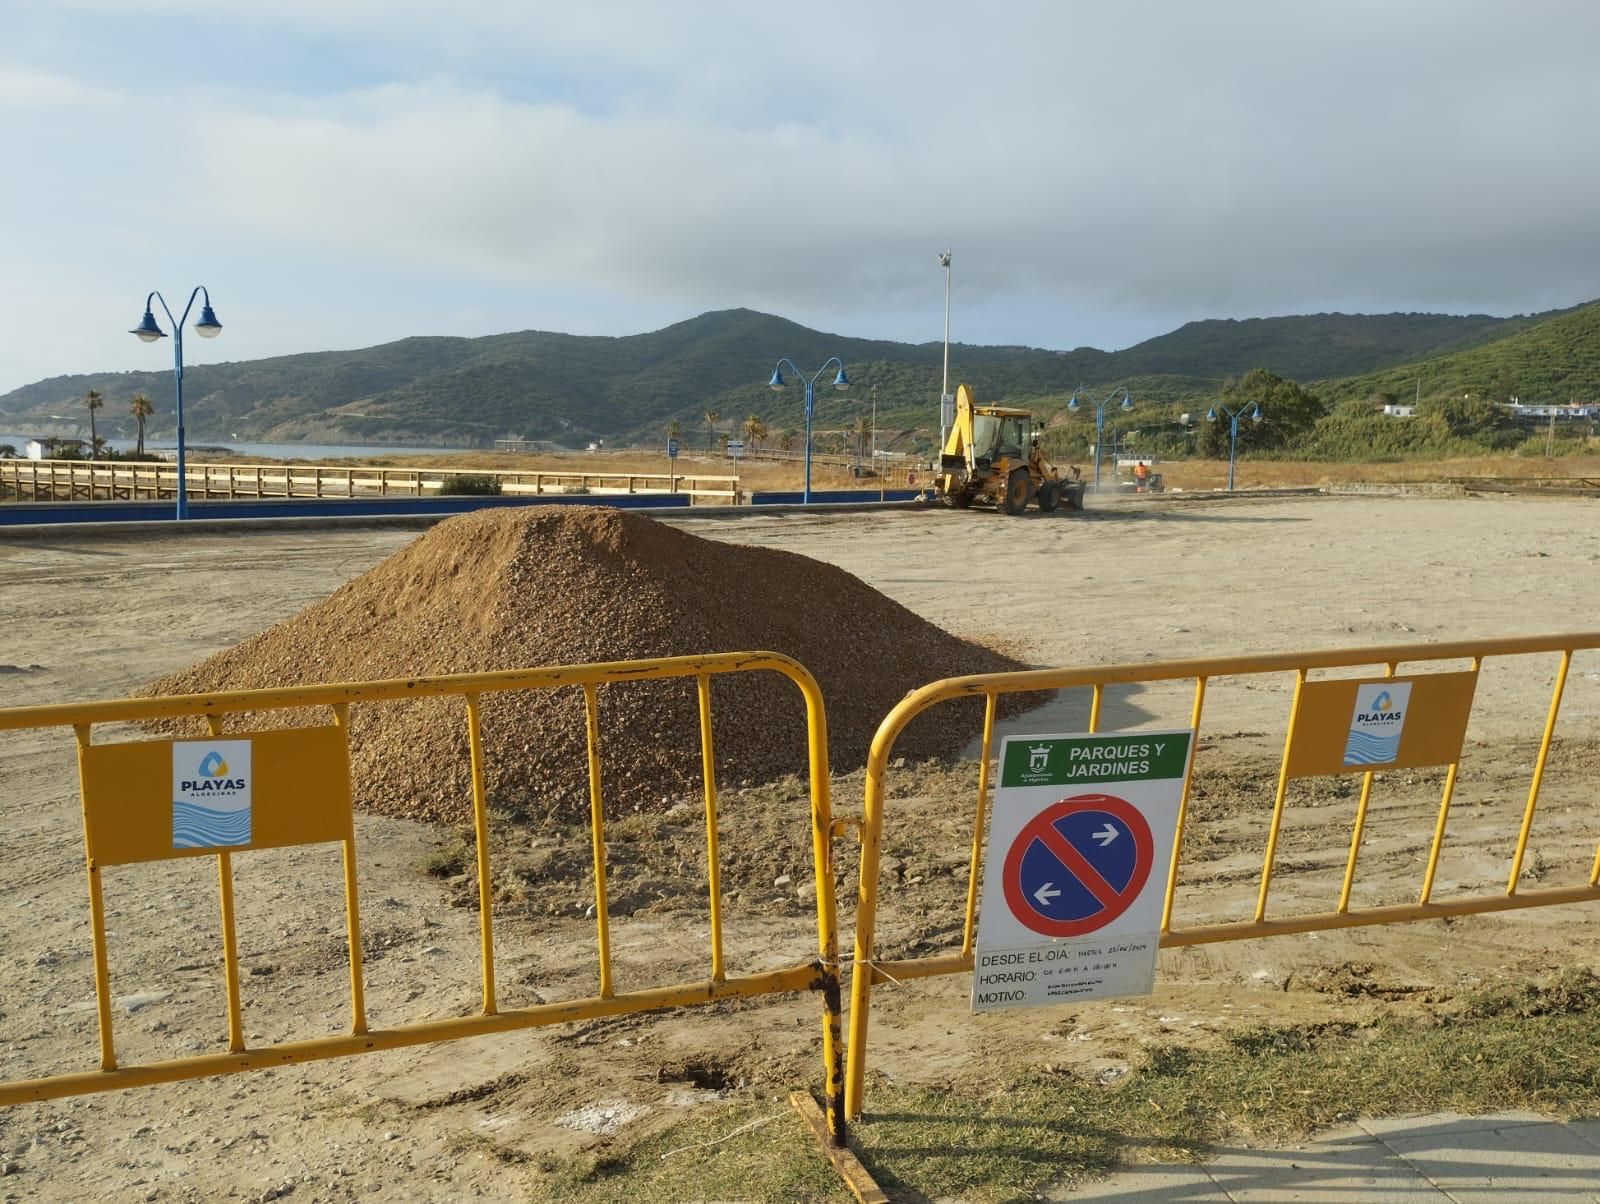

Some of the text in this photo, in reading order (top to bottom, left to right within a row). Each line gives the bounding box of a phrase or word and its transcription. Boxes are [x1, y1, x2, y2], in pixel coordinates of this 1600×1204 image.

[1357, 711, 1401, 722] PLAYAS
[1070, 743, 1165, 760] PARQUES Y
[1067, 761, 1150, 777] JARDINES
[181, 779, 245, 791] PLAYAS
[981, 954, 1026, 967] DESDE
[1028, 952, 1043, 962] EL
[980, 971, 1037, 984] HORARIO:
[978, 990, 1027, 1004] MOTIVO:
